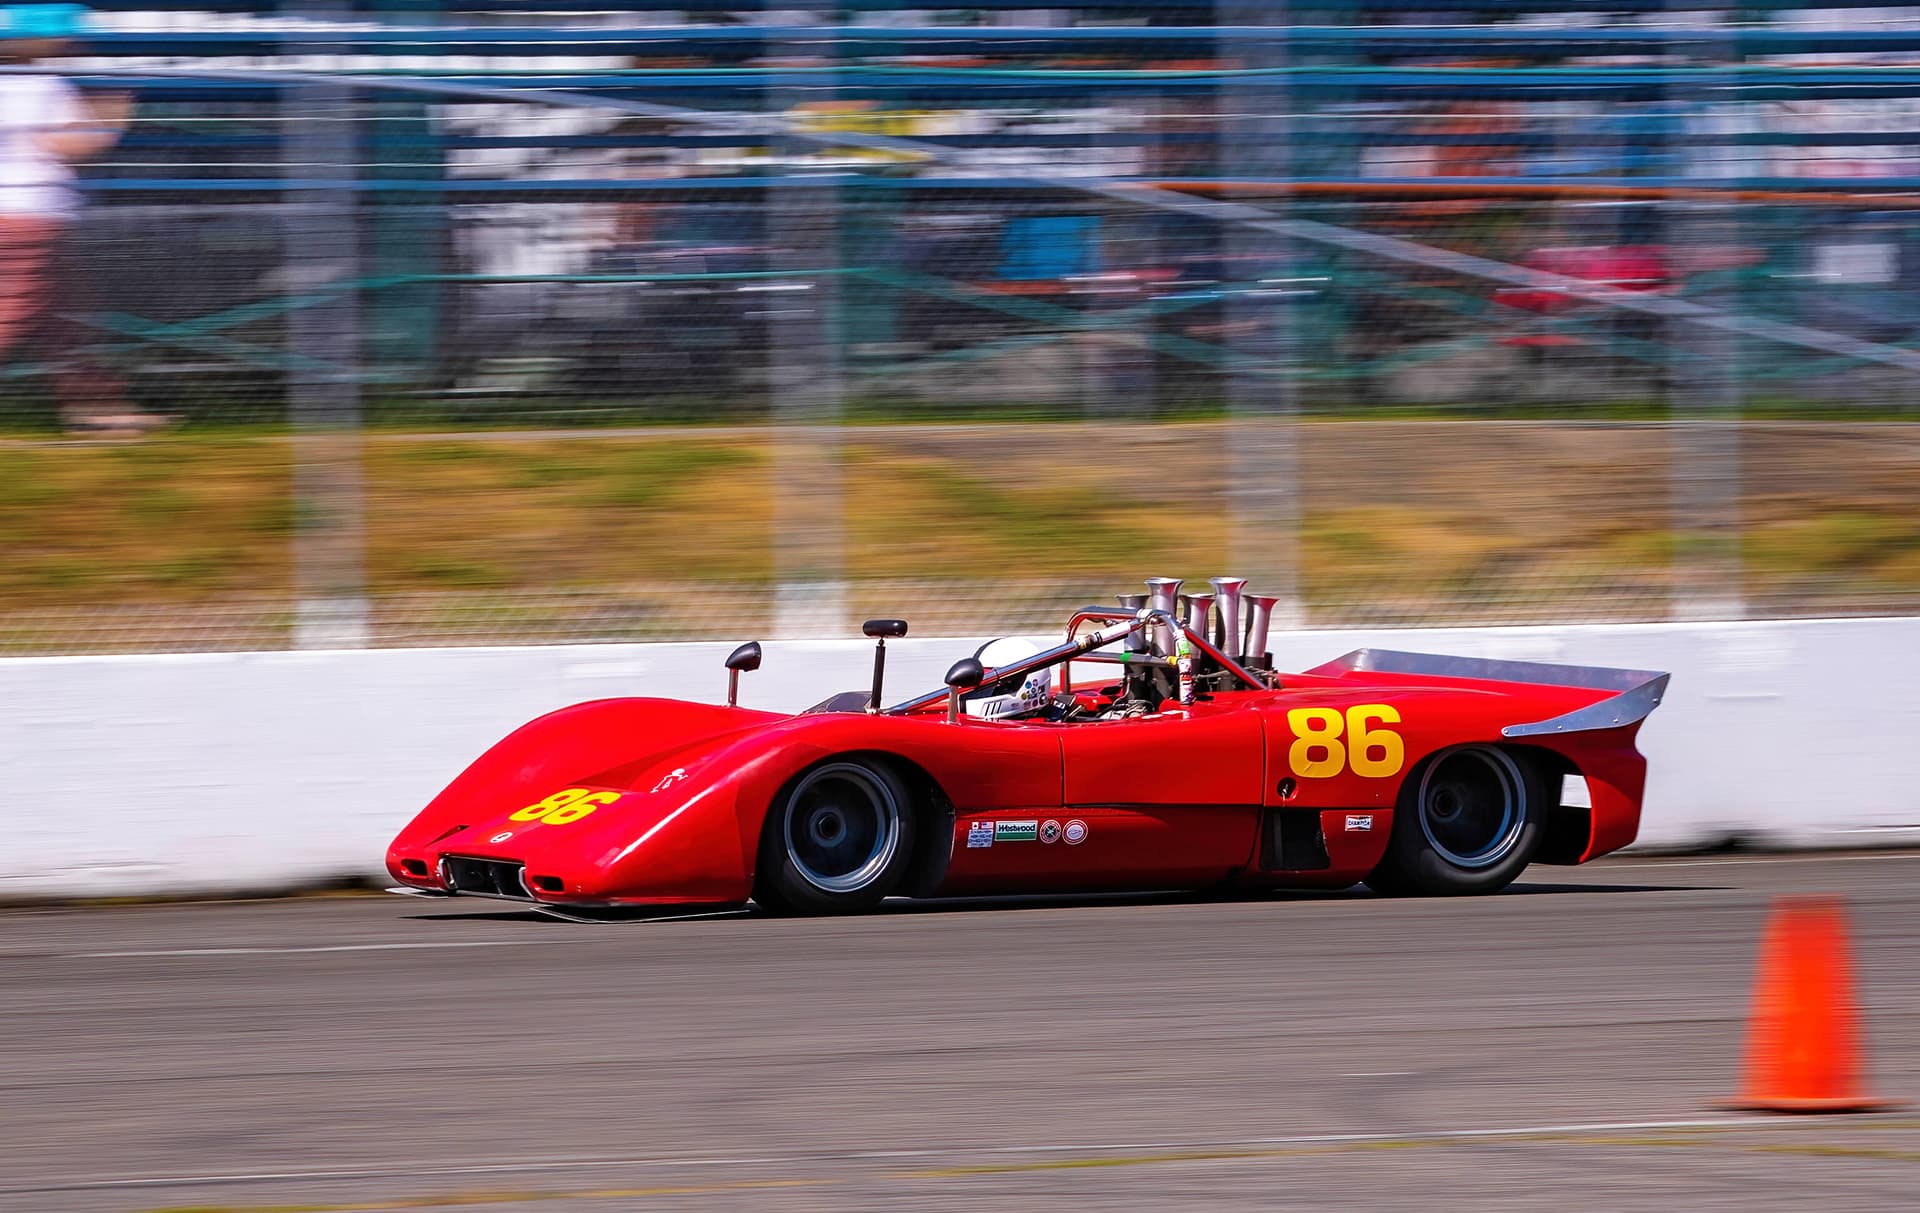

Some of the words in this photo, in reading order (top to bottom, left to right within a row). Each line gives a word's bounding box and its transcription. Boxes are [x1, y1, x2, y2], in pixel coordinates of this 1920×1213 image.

[1287, 704, 1405, 779] 86
[508, 788, 622, 825] 86
[998, 823, 1036, 832] Westwood
